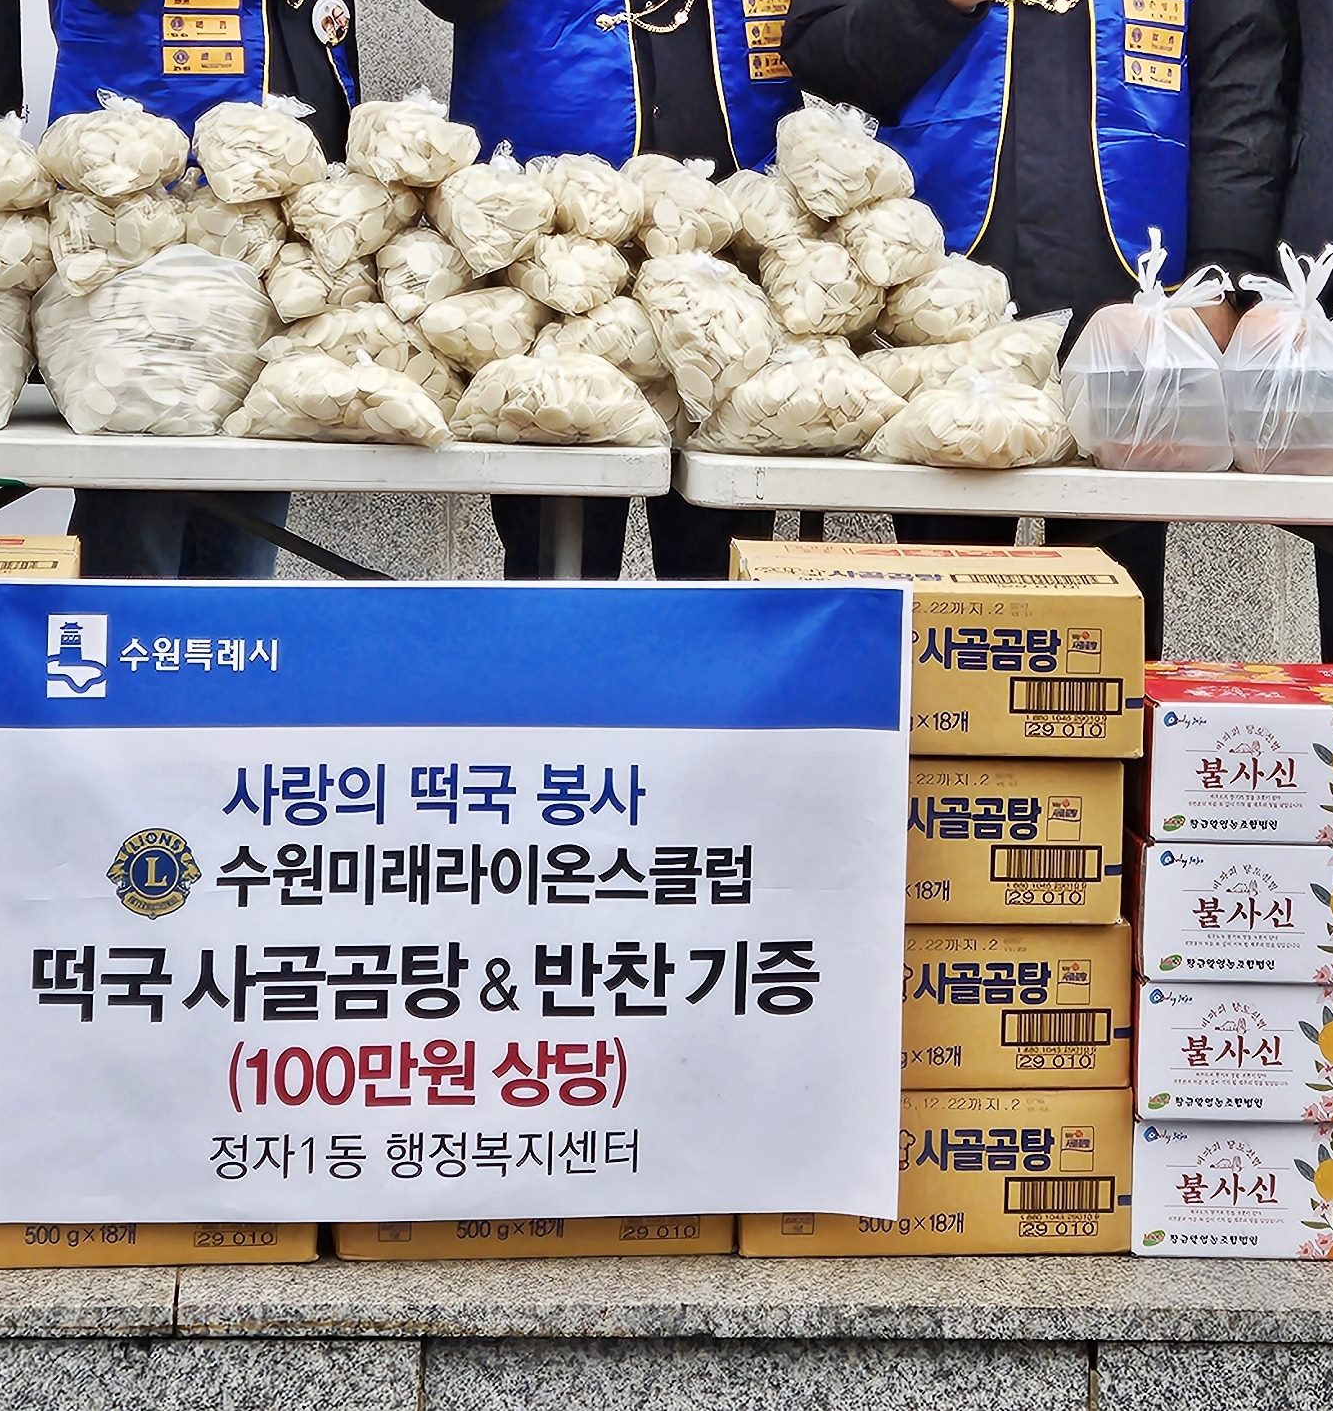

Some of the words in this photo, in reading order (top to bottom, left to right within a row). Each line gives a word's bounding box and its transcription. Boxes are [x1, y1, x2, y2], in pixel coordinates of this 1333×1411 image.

[119, 638, 280, 673] 수원특례시
[919, 627, 1062, 672] 사골곰탕
[1027, 723, 1055, 738] 29
[1062, 723, 1103, 738] 010
[1195, 756, 1298, 791] 불사신
[223, 763, 386, 827] 사랑의
[409, 765, 516, 826] 떡국
[536, 763, 645, 824] 봉사
[908, 797, 1042, 840] 사골곰탕
[128, 832, 182, 851] LIONS
[144, 856, 168, 887] L
[217, 844, 753, 906] 수원미래라이온스클럽
[1008, 891, 1035, 905] 29
[1043, 891, 1082, 905] 010
[1192, 896, 1294, 930] 불사신
[31, 946, 169, 1023] 떡국
[182, 943, 469, 1023] 사골곰탕
[479, 957, 520, 1012] &
[534, 940, 669, 1019] 반찬
[686, 940, 821, 1017] 기증
[913, 962, 1052, 1005] 사골곰탕
[1019, 1055, 1045, 1069] 29
[1053, 1055, 1092, 1069] 010
[1181, 1035, 1283, 1069] 불사신
[229, 1040, 475, 1112] (100만원
[493, 1038, 628, 1108] 상당)
[209, 1133, 362, 1181] 정자1동
[385, 1129, 639, 1177] 행정복지센터
[916, 1128, 1055, 1171] 사골곰탕
[1175, 1172, 1278, 1206] 불사신
[25, 1225, 61, 1245] 500
[197, 1231, 223, 1246] 29
[232, 1231, 275, 1246] 010
[456, 1220, 491, 1239] 500
